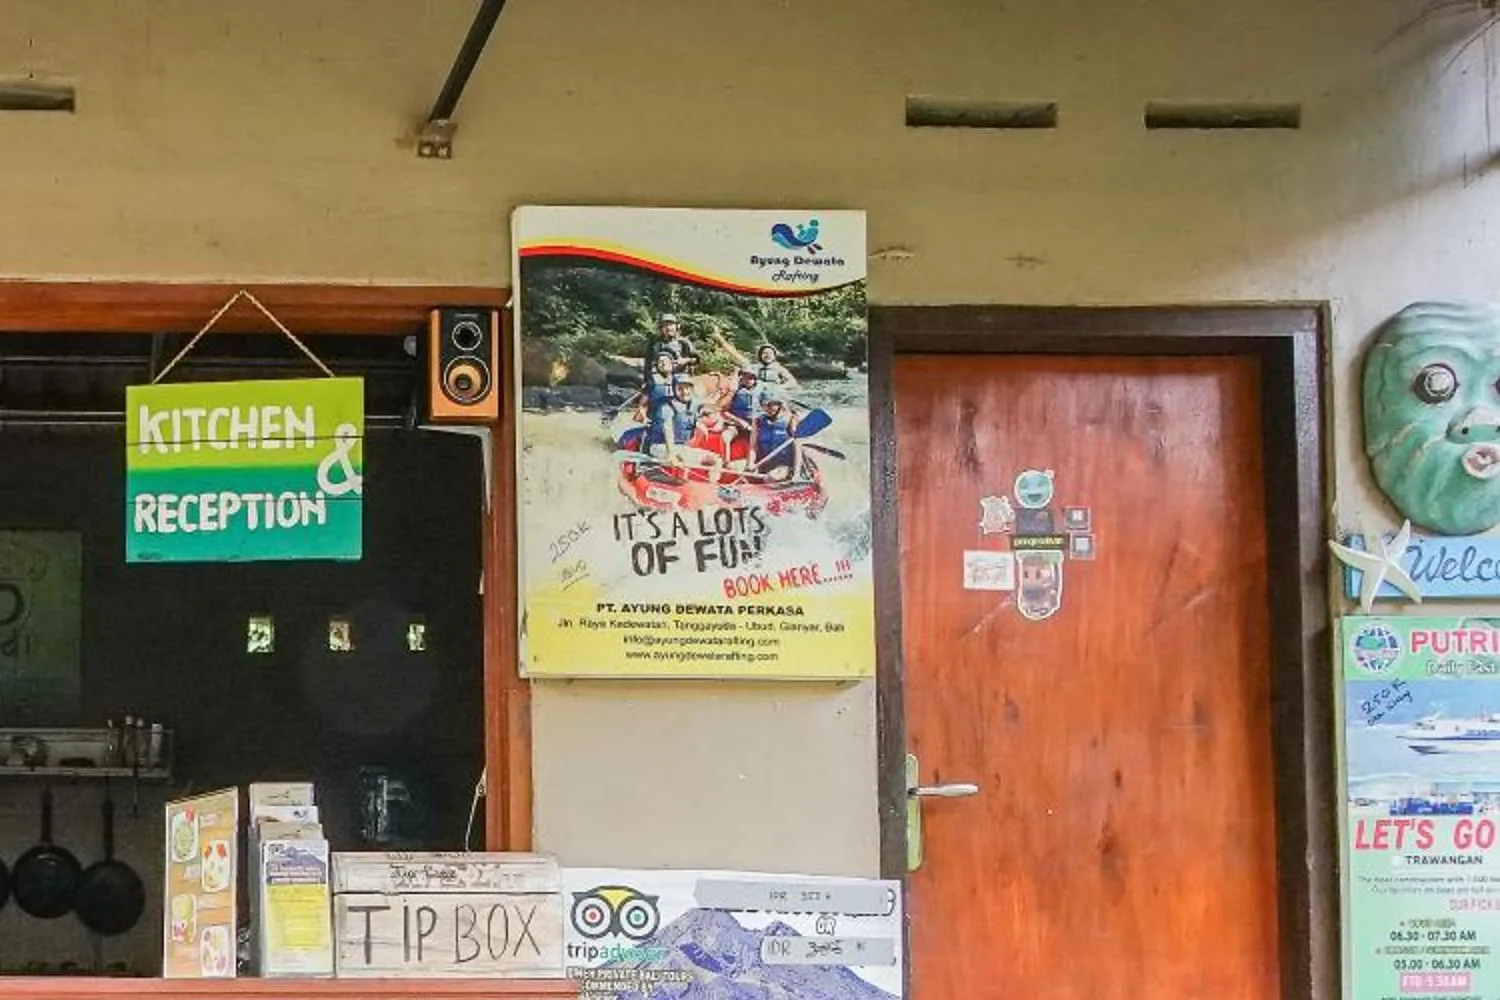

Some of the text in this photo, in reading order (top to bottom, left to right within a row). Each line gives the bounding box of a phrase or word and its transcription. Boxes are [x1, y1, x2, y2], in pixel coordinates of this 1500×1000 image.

[137, 404, 363, 496] KITCHEN &
[133, 490, 327, 533] RECEPTION
[612, 505, 766, 541] IT'S A LOTS
[631, 540, 680, 577] OF
[694, 535, 763, 574] FUN
[723, 574, 774, 599] BOOK
[596, 603, 805, 616] PT. AYUNG DEWATA PERKASA
[1411, 630, 1500, 654] PUTRI
[1354, 818, 1495, 850] LET'S GO
[1404, 855, 1484, 866] TRAWANGAN
[454, 902, 543, 963] BOX
